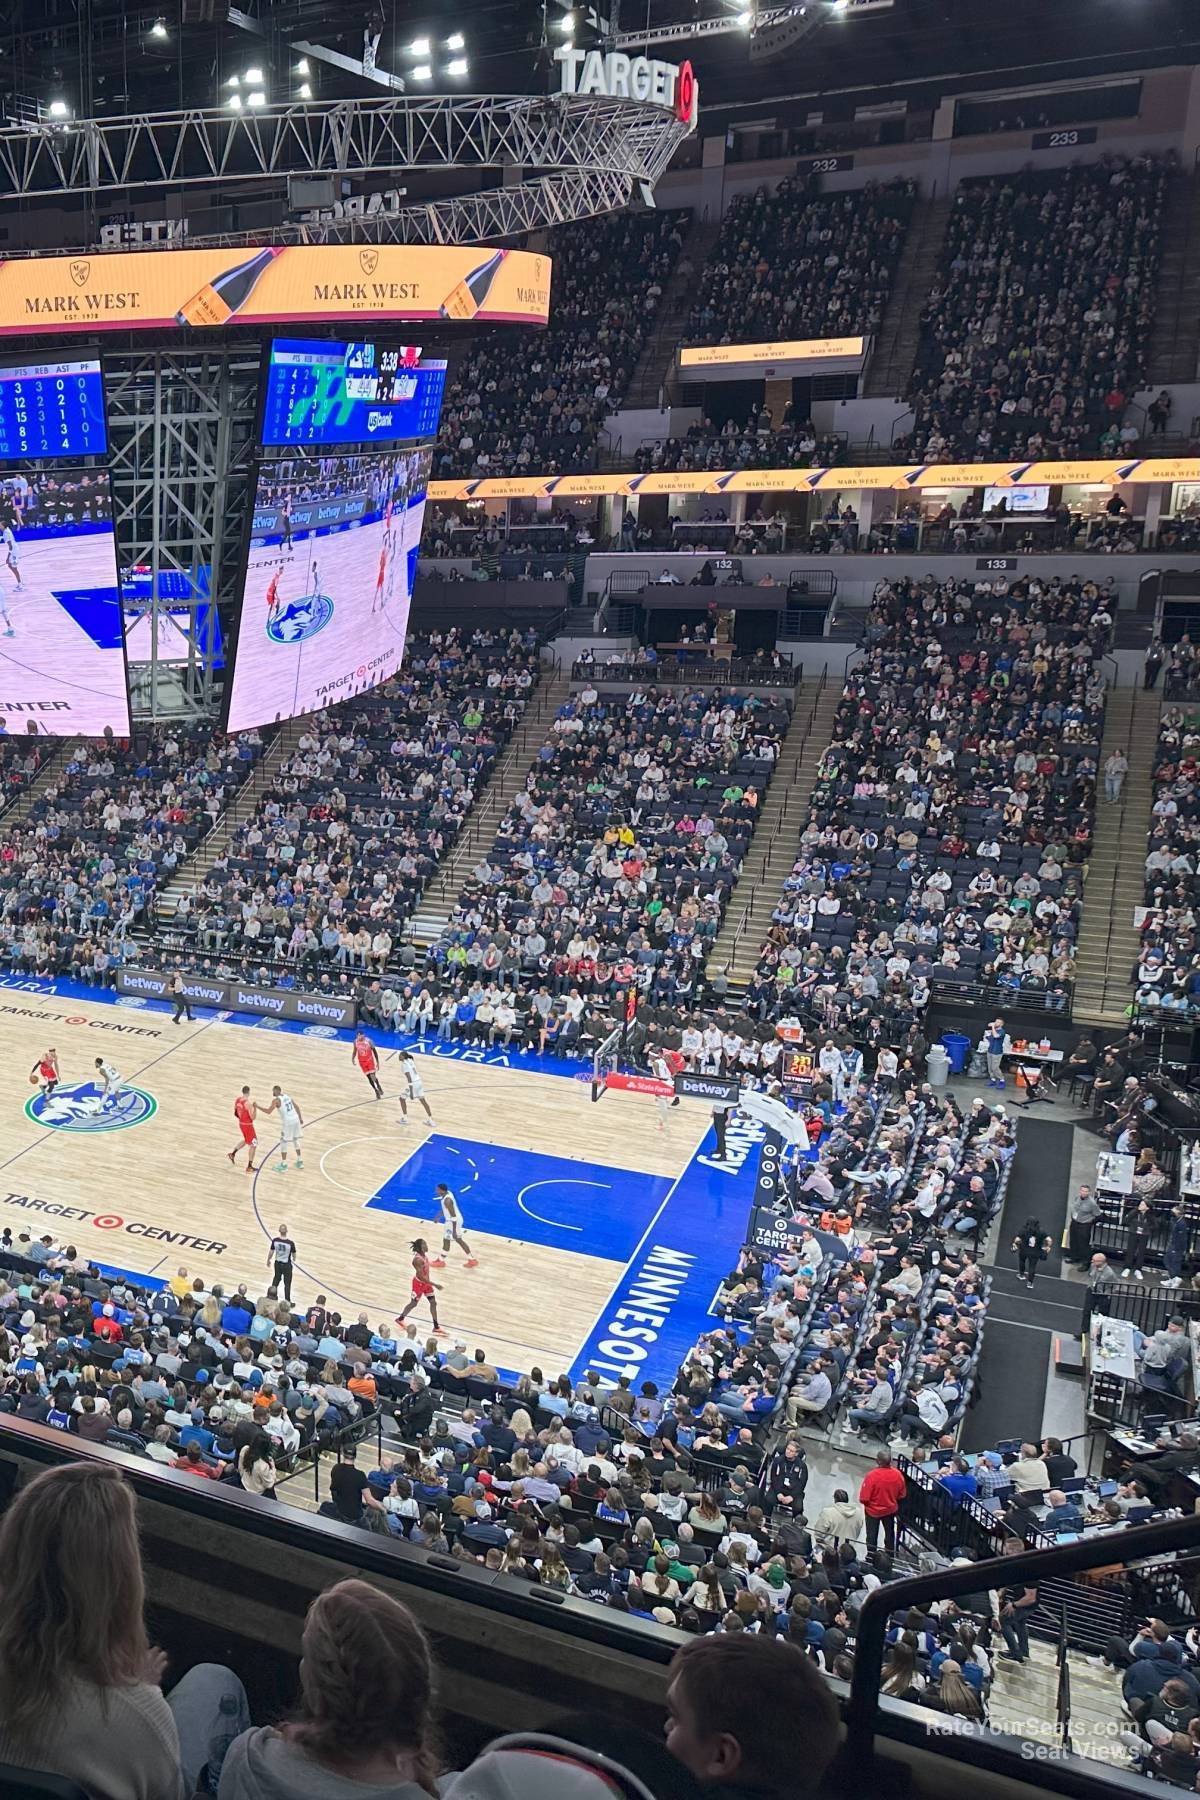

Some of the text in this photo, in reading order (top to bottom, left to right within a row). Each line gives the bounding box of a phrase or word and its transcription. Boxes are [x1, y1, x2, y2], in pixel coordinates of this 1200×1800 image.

[554, 47, 680, 107] TARGET
[1049, 130, 1078, 146] 233
[812, 158, 838, 173] 232
[314, 283, 367, 300] MARK
[517, 287, 536, 302] MARK
[25, 295, 80, 314] MARK
[381, 352, 398, 371] 3:38
[15, 363, 89, 377] PTS REB AST PF
[14, 382, 22, 394] 3
[35, 381, 43, 392] 3
[56, 379, 64, 391] 0
[78, 377, 86, 389] 0
[14, 393, 87, 409] 12 2 2 0
[382, 388, 387, 400] 2
[16, 410, 45, 423] 15 3
[19, 426, 27, 437] 8
[60, 424, 68, 435] 3
[82, 422, 89, 433] 0
[0, 438, 69, 452] 12 5 2 4
[252, 501, 364, 529] etway betway betway
[247, 557, 295, 570] CENTER
[714, 560, 732, 570] 132
[986, 559, 1007, 570] 133
[315, 648, 395, 697] TARGET CENTER
[124, 975, 166, 994] betway
[238, 992, 284, 1011] betway
[297, 1000, 345, 1021] betway
[0, 1005, 162, 1038] TARGET CENTER
[791, 1063, 806, 1075] 20
[683, 1080, 731, 1097] betway
[2, 1193, 228, 1255] TARGET CENTER
[757, 1228, 803, 1244] TARGET
[276, 1335, 288, 1347] 32
